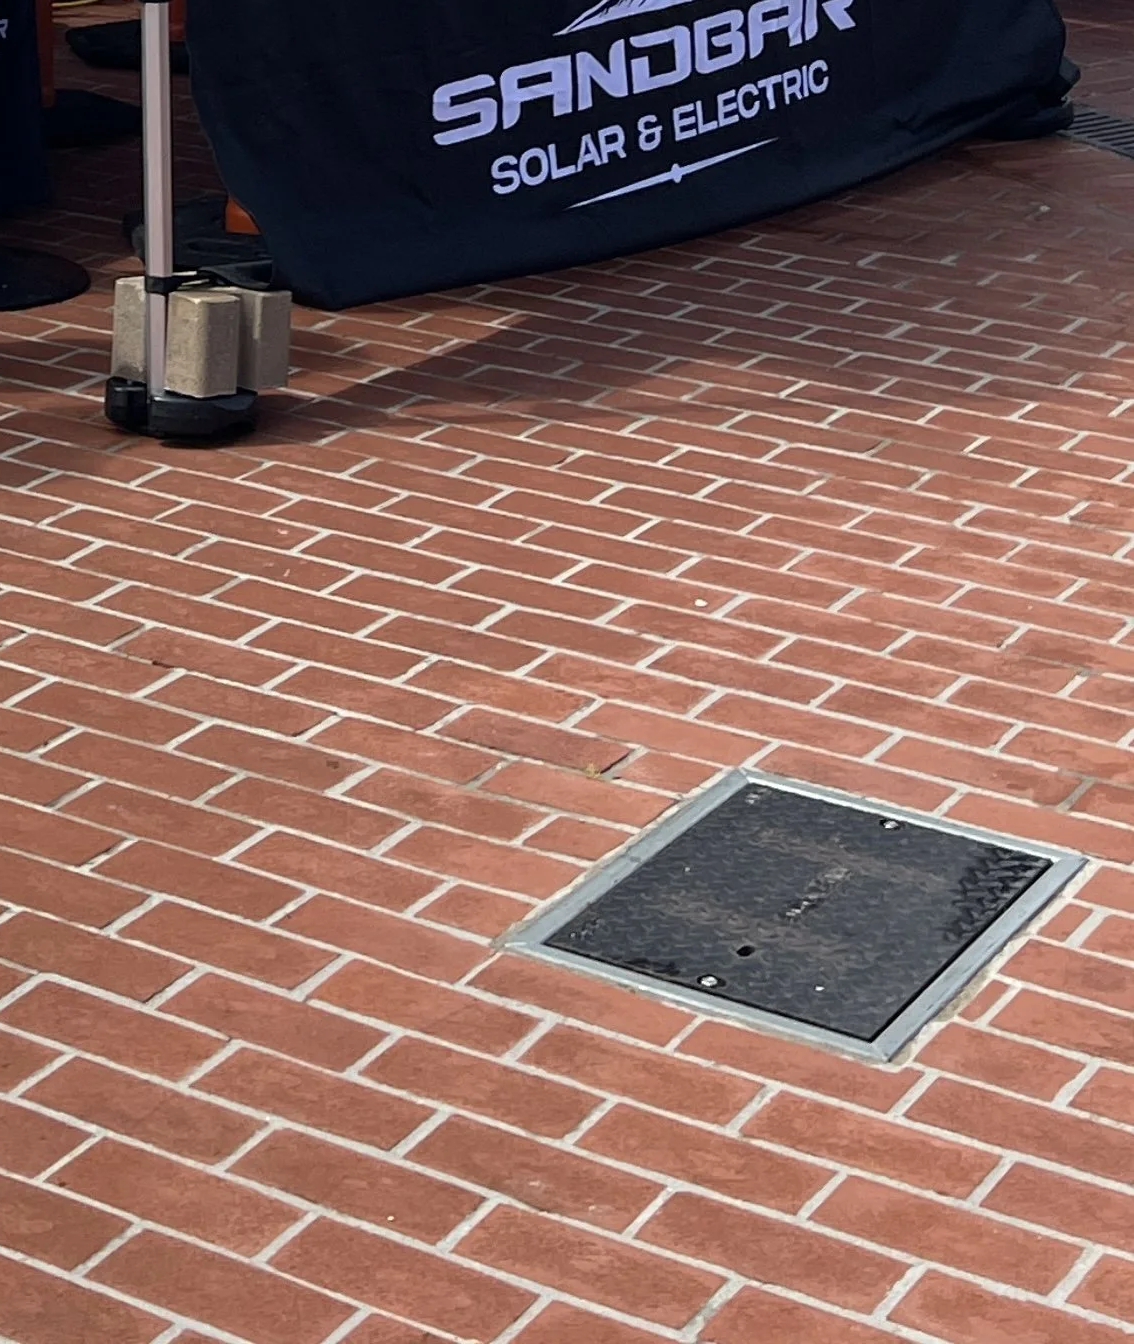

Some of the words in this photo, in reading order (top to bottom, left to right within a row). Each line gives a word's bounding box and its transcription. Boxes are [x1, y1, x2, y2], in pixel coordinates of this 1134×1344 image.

[490, 124, 627, 195] SOLAR
[637, 114, 664, 151] &
[673, 59, 830, 141] ELECTRIC
